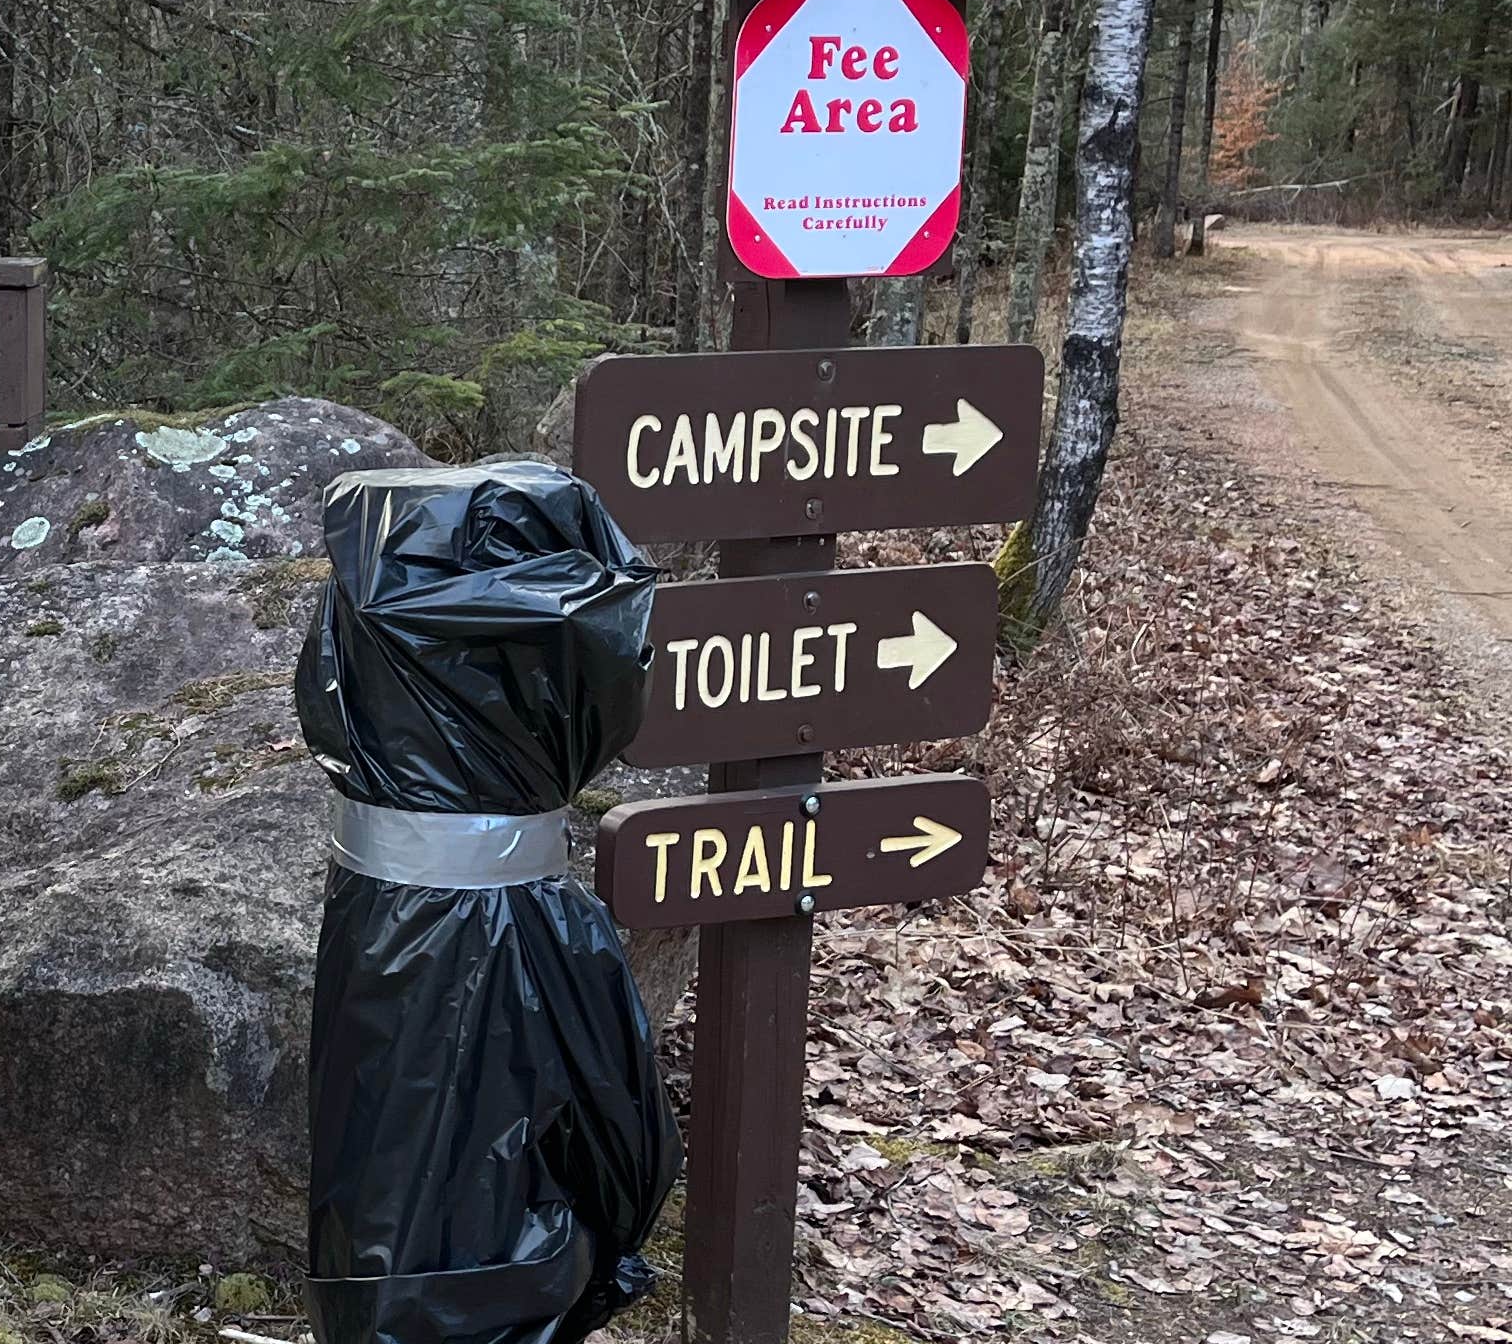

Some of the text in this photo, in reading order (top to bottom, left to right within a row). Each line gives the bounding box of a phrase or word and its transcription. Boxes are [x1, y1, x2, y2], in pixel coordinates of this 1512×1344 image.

[807, 35, 900, 81] Fee
[780, 89, 920, 134] Area
[763, 194, 928, 211] Read Instructions
[802, 215, 888, 232] Carefully
[626, 405, 903, 489] CAMPSITE
[667, 622, 858, 710] TOILET
[645, 820, 833, 903] TRAIL
